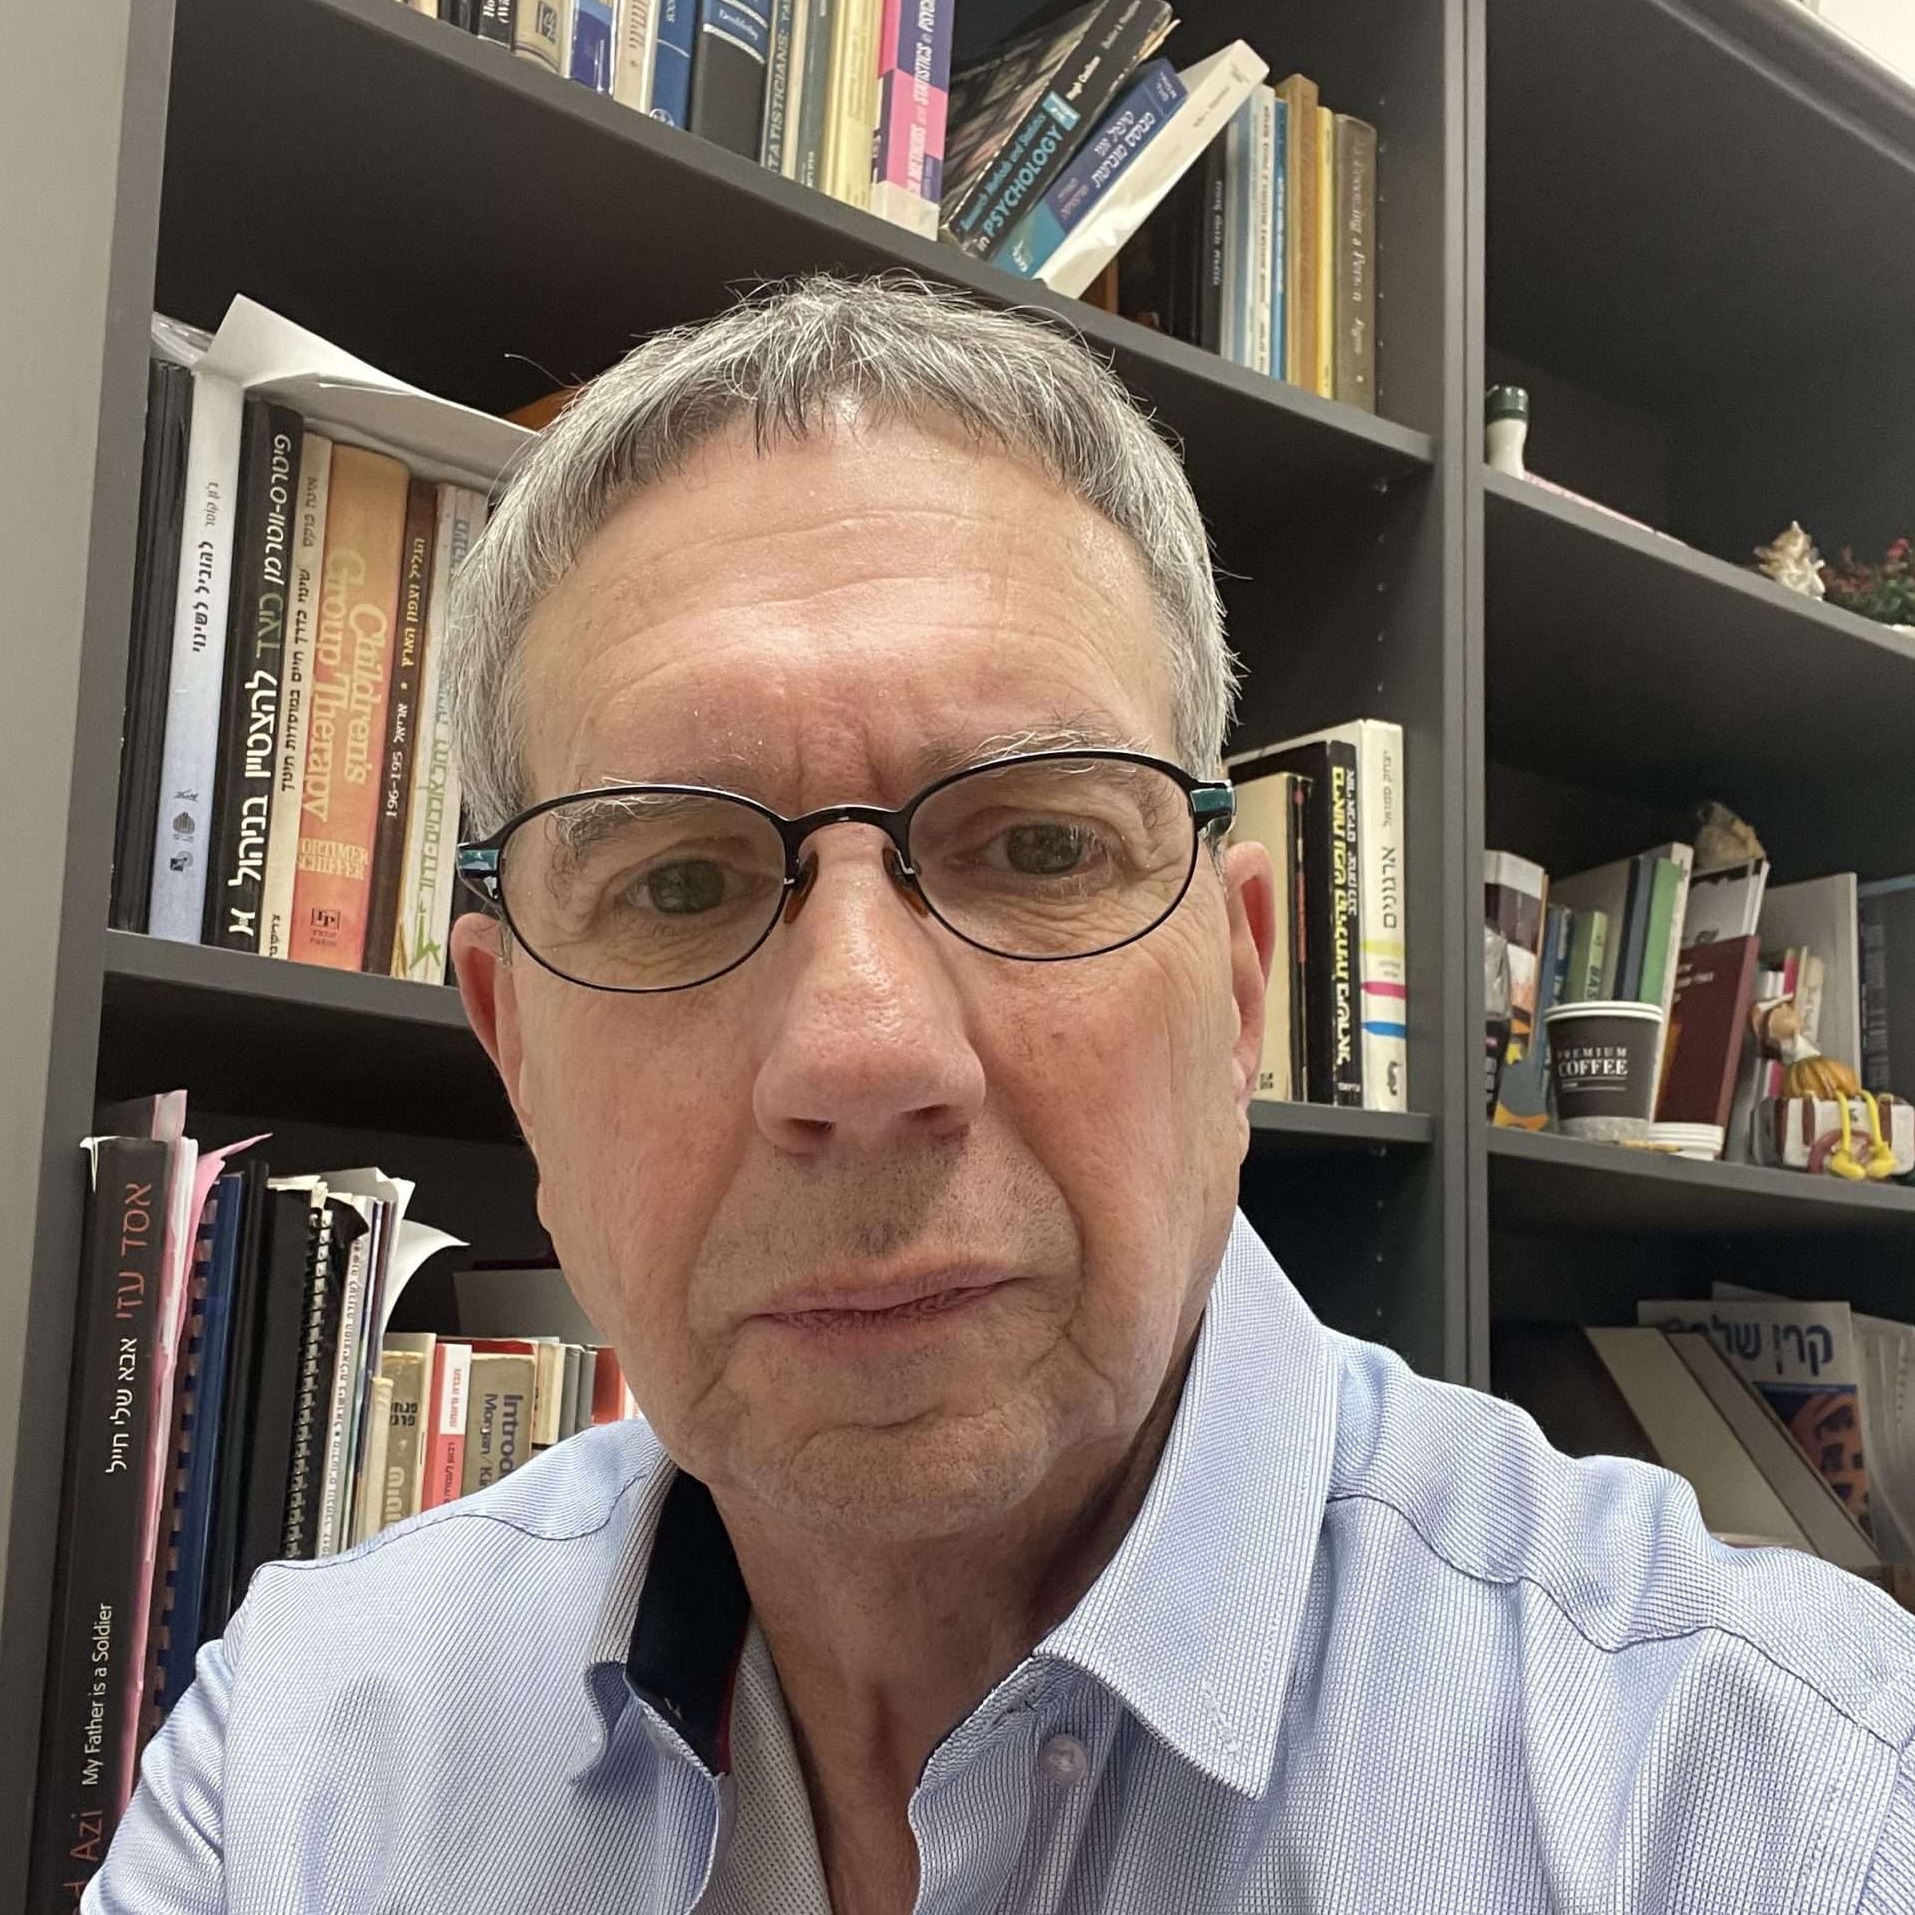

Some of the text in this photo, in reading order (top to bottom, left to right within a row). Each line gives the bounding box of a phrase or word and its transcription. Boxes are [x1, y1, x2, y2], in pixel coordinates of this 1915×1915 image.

[764, 28, 792, 174] TATISTICIANS:
[909, 42, 935, 106] STATISTICS
[976, 236, 992, 253] in
[984, 125, 1063, 235] PSYCHOLOGY
[1352, 251, 1365, 302] Persn
[193, 540, 215, 595] להוביל
[295, 567, 311, 604] שינוי
[408, 537, 426, 580] הגליל
[189, 601, 211, 654] לשינוי
[401, 627, 416, 669] הארץ
[227, 433, 296, 889] פיטרס-ווטרמן כיצד להצטיין בניהול
[290, 650, 305, 683] חיים
[300, 548, 369, 823] Group Therapy
[284, 688, 302, 751] במוסדות
[343, 603, 389, 786] Children's
[393, 702, 409, 744] אריאל
[280, 755, 298, 793] חינוך
[385, 749, 404, 819] 196-195
[1381, 846, 1397, 929] ארגונים
[1336, 982, 1352, 1065] בישראל
[1557, 1047, 1627, 1058] PREMIUM
[1558, 1059, 1628, 1077] COFFEE
[104, 1180, 153, 1474] אסד עזי אבא שלי חייל
[1773, 1324, 1834, 1376] קרן
[92, 1603, 112, 1663] Soldier
[89, 1684, 105, 1698] is
[93, 1668, 107, 1679] a
[84, 1702, 104, 1759] Father
[81, 1757, 103, 1787] My
